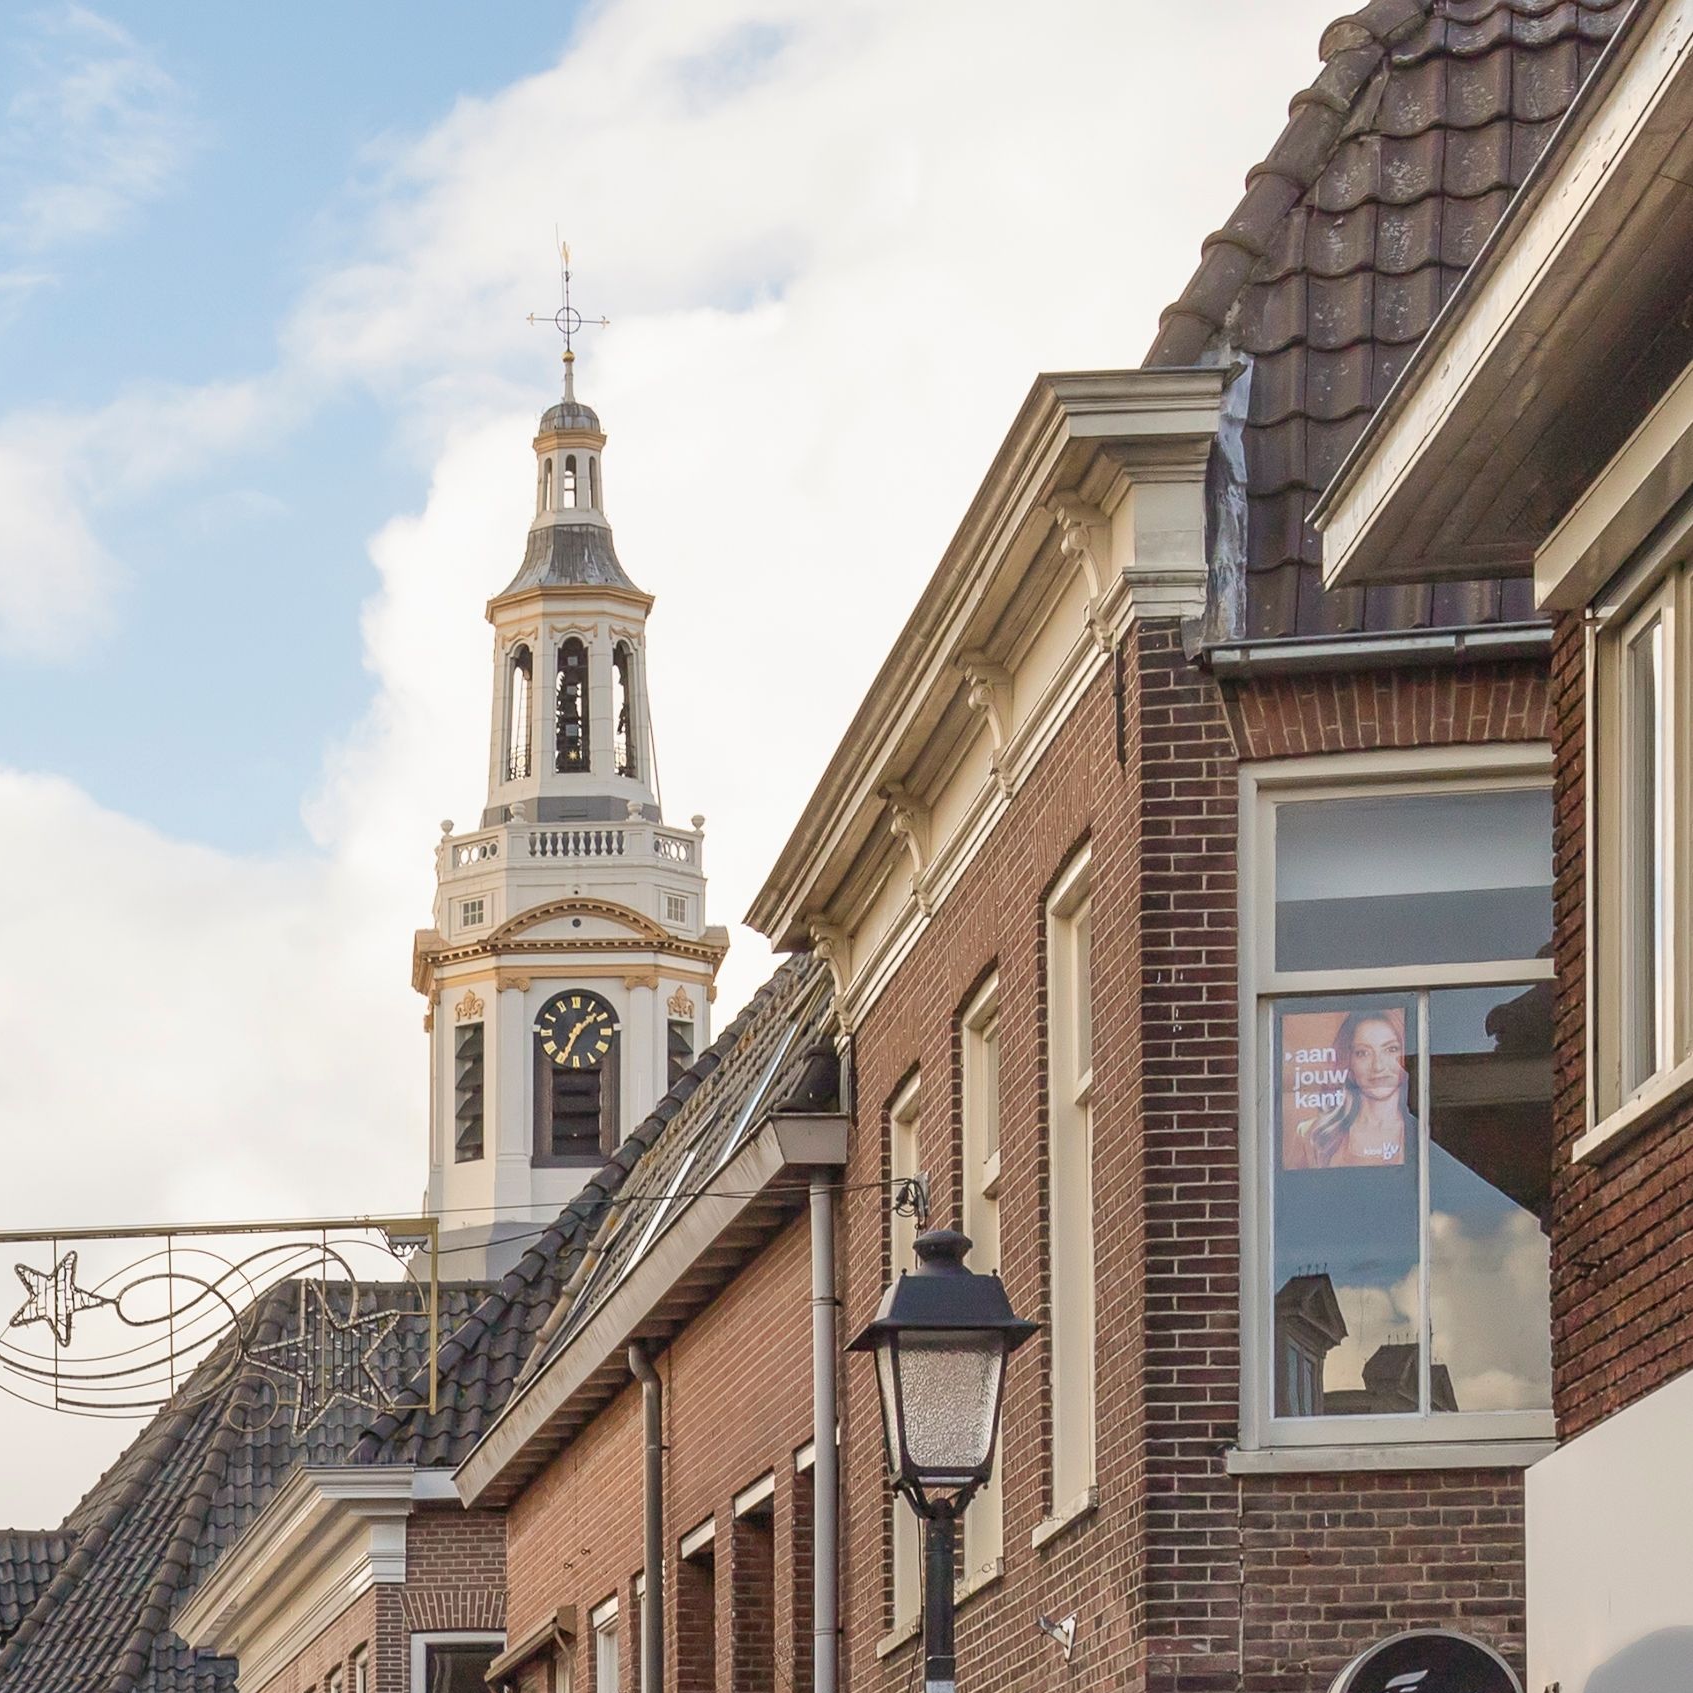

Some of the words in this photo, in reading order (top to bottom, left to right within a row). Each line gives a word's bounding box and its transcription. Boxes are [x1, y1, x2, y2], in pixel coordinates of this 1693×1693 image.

[1295, 1047, 1336, 1064] aan
[1294, 1067, 1349, 1091] jouw
[1295, 1090, 1346, 1110] kant
